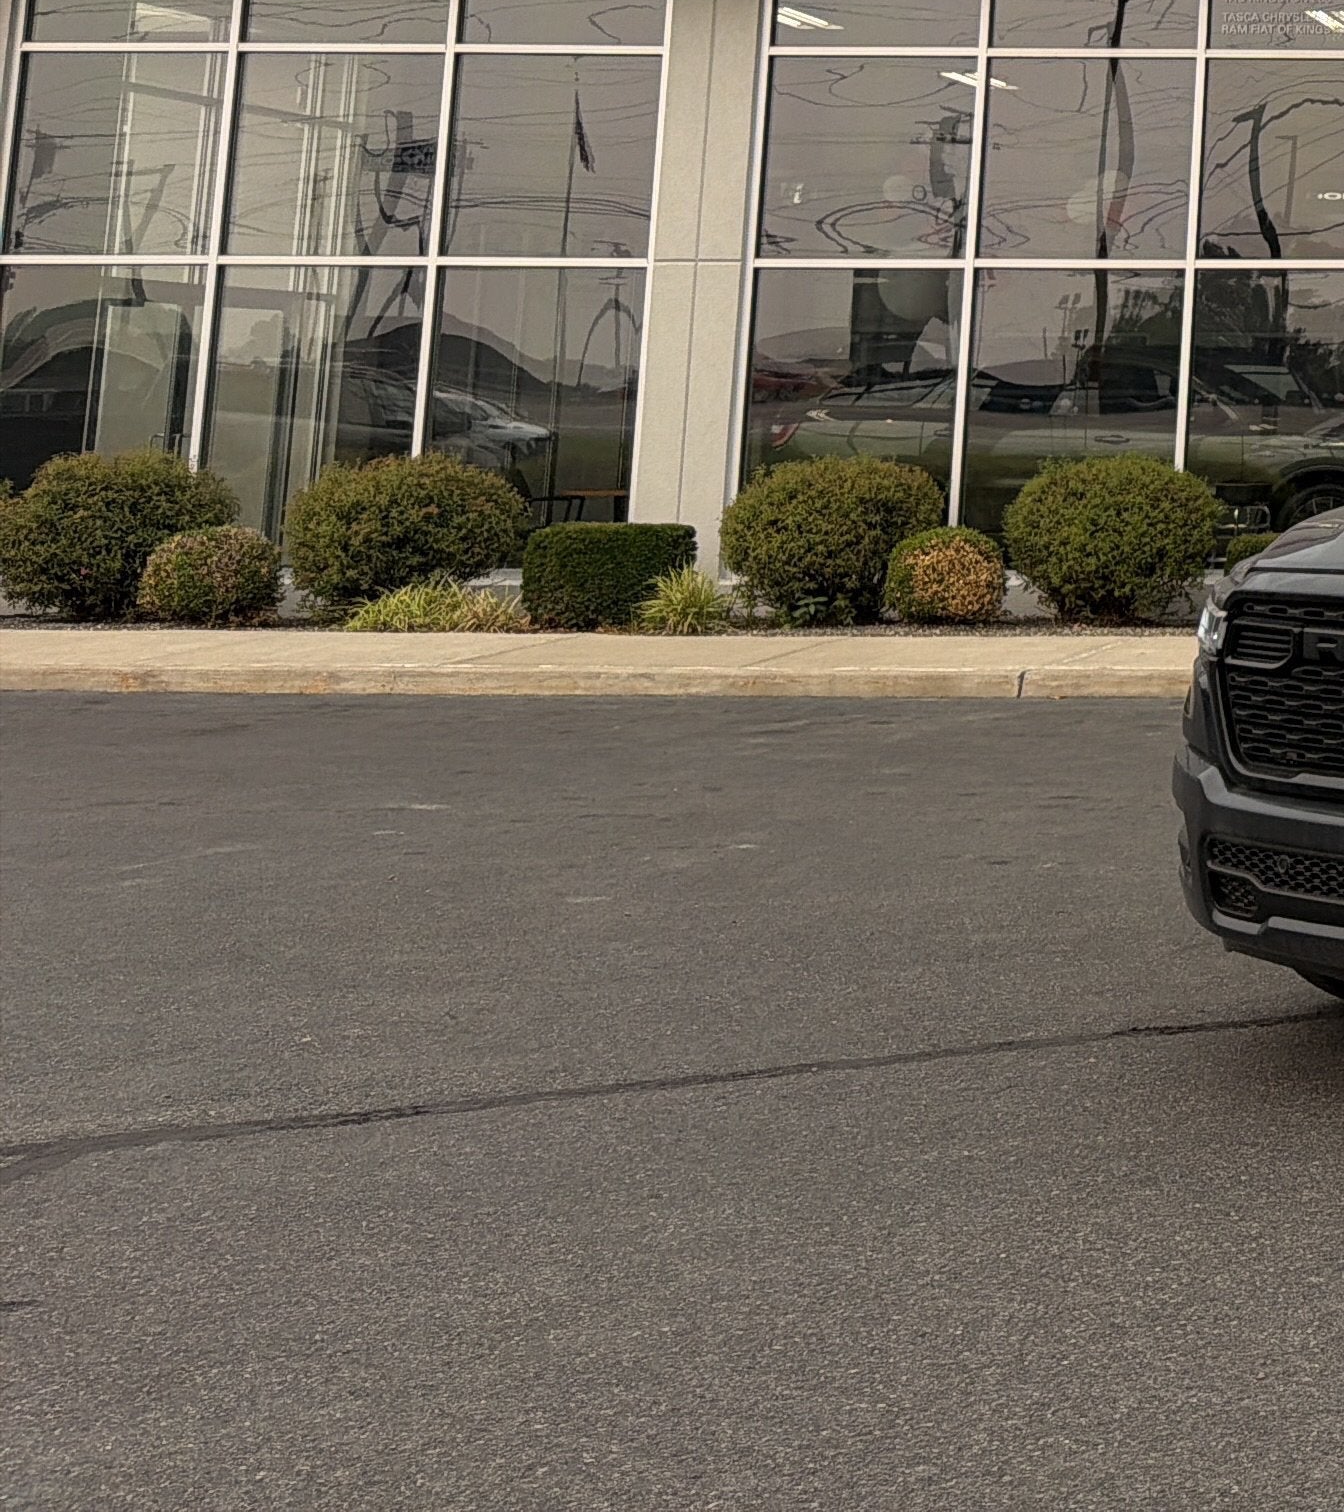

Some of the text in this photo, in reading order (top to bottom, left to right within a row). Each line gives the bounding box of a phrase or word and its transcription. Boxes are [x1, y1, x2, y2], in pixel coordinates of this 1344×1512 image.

[1222, 11, 1261, 23] TASCA
[1220, 23, 1248, 35] RAM
[1250, 23, 1274, 35] FIAT
[1278, 23, 1295, 35] OF
